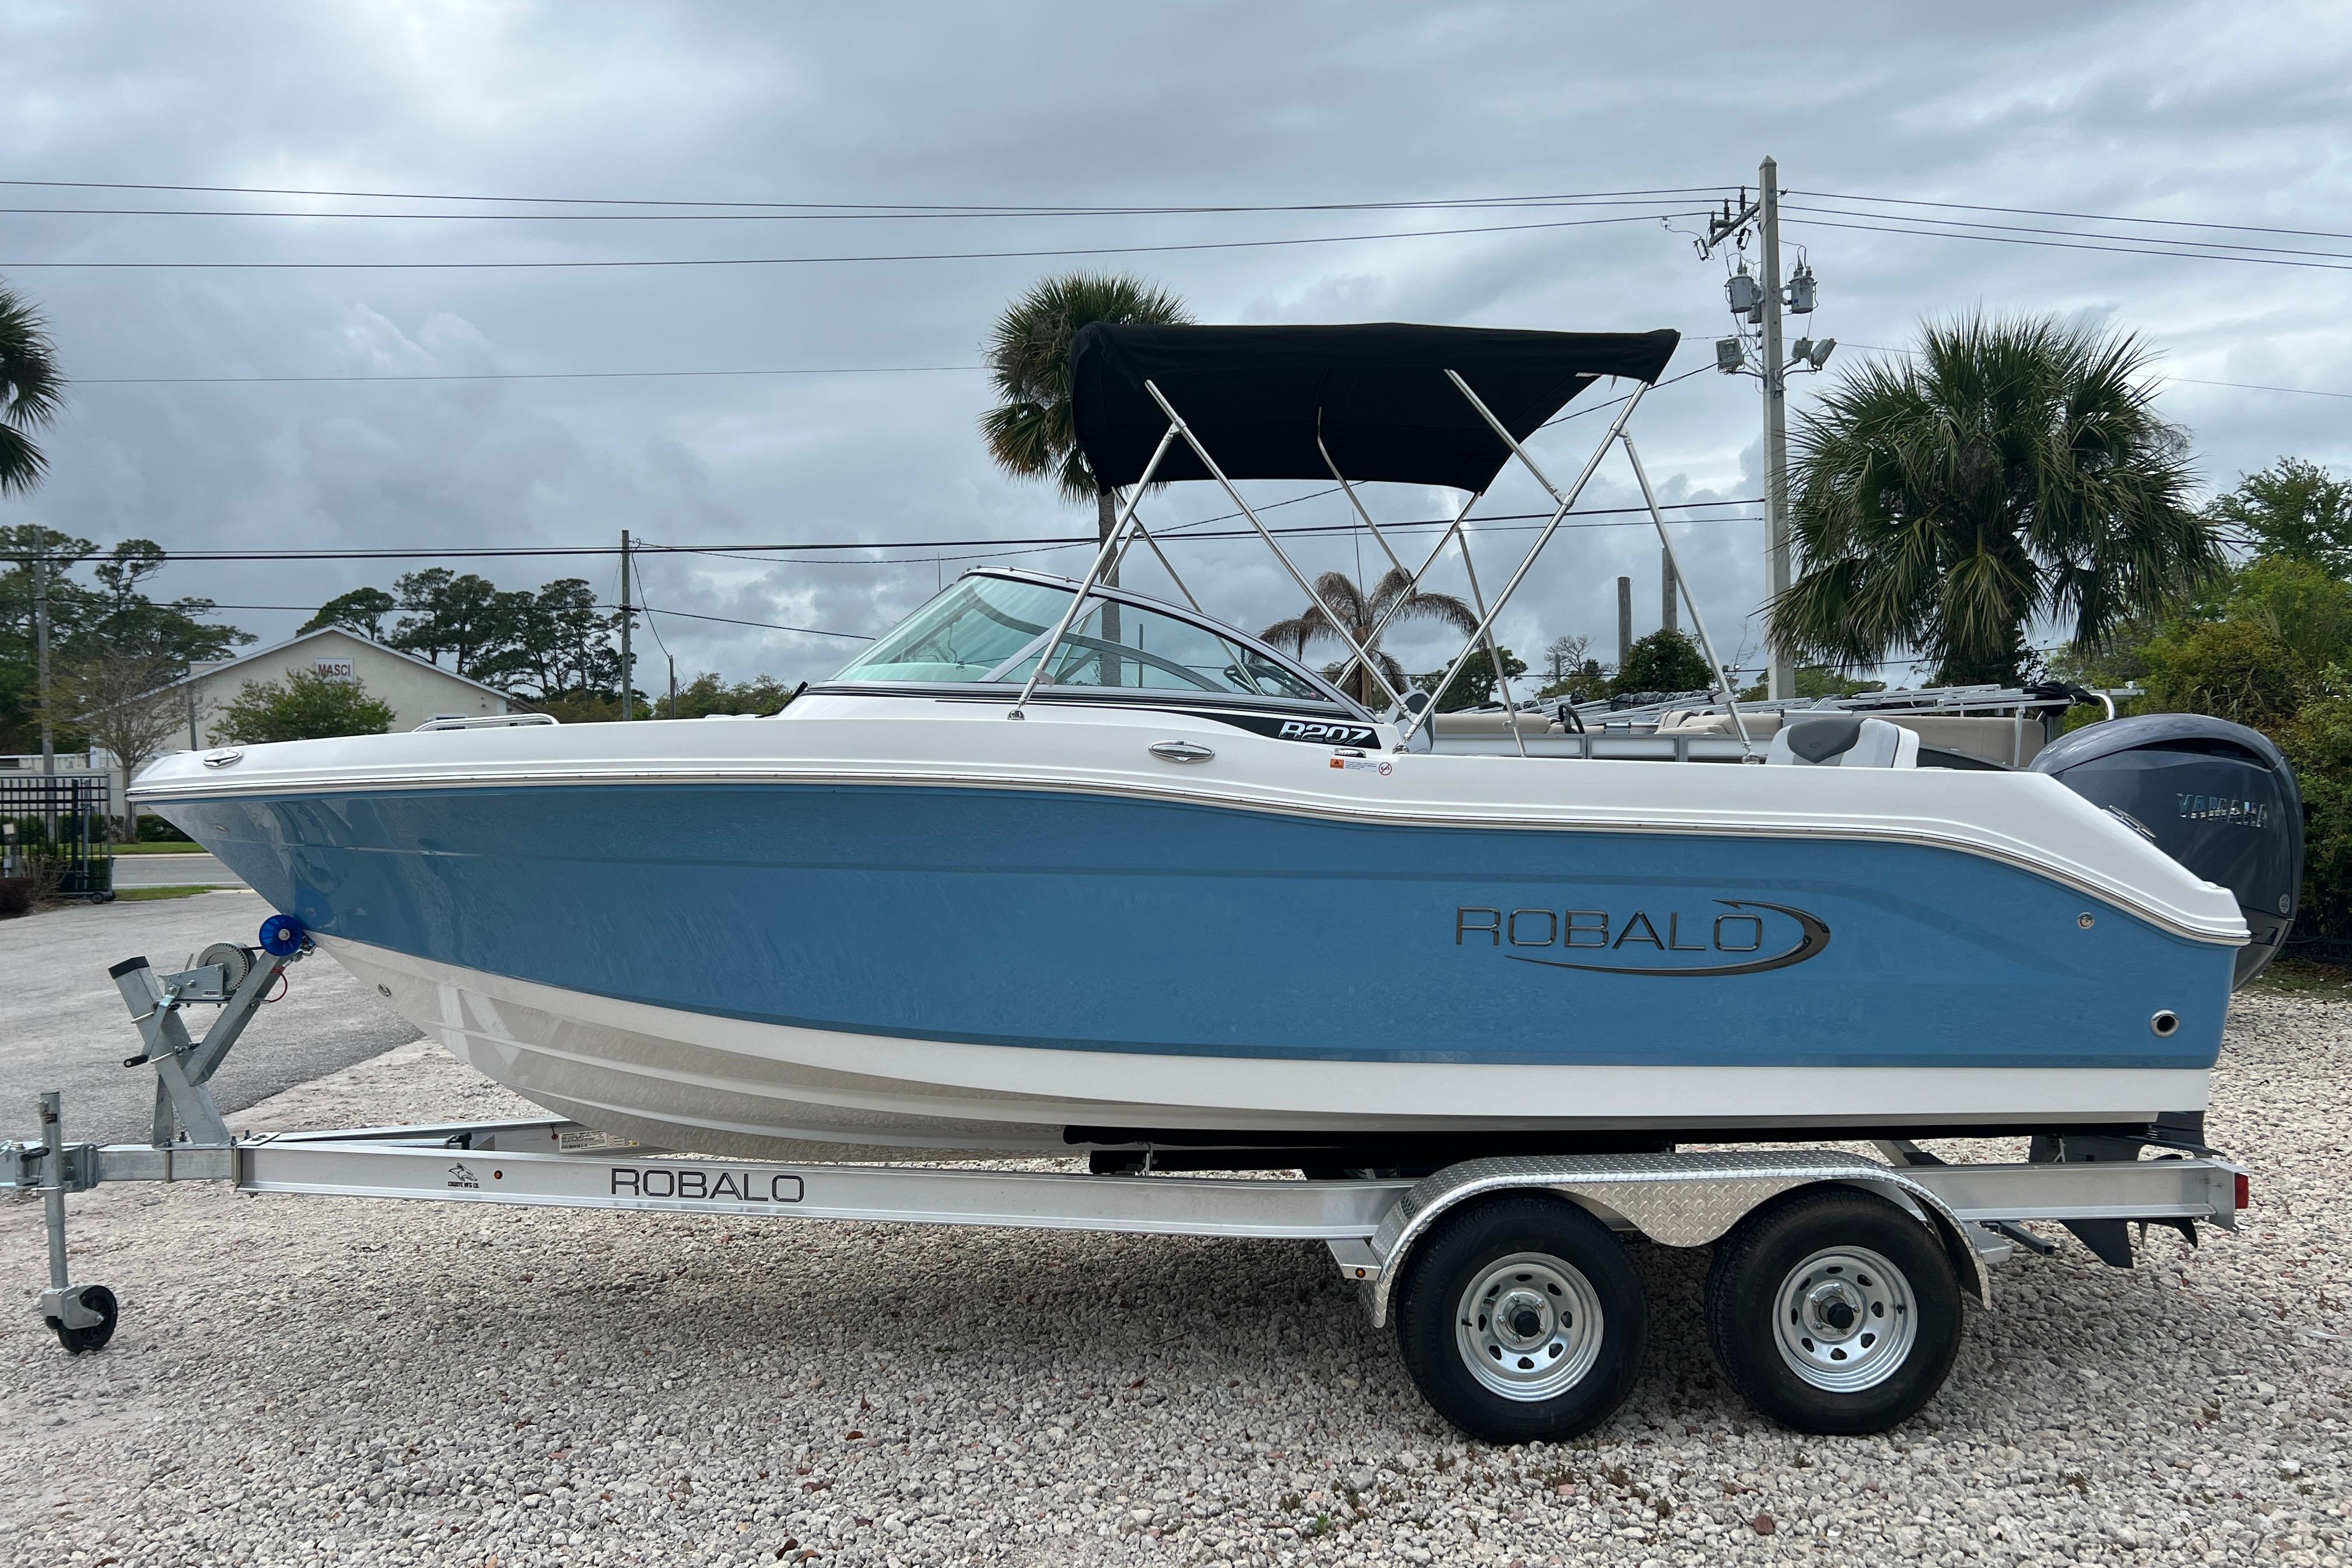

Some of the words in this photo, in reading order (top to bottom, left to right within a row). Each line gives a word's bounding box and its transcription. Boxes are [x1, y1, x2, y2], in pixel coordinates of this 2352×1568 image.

[318, 664, 351, 676] MASCI
[1278, 721, 1372, 745] R207
[2176, 793, 2268, 829] YAMAHA
[1455, 906, 1762, 951] ROBALO
[611, 1168, 804, 1202] ROBALO
